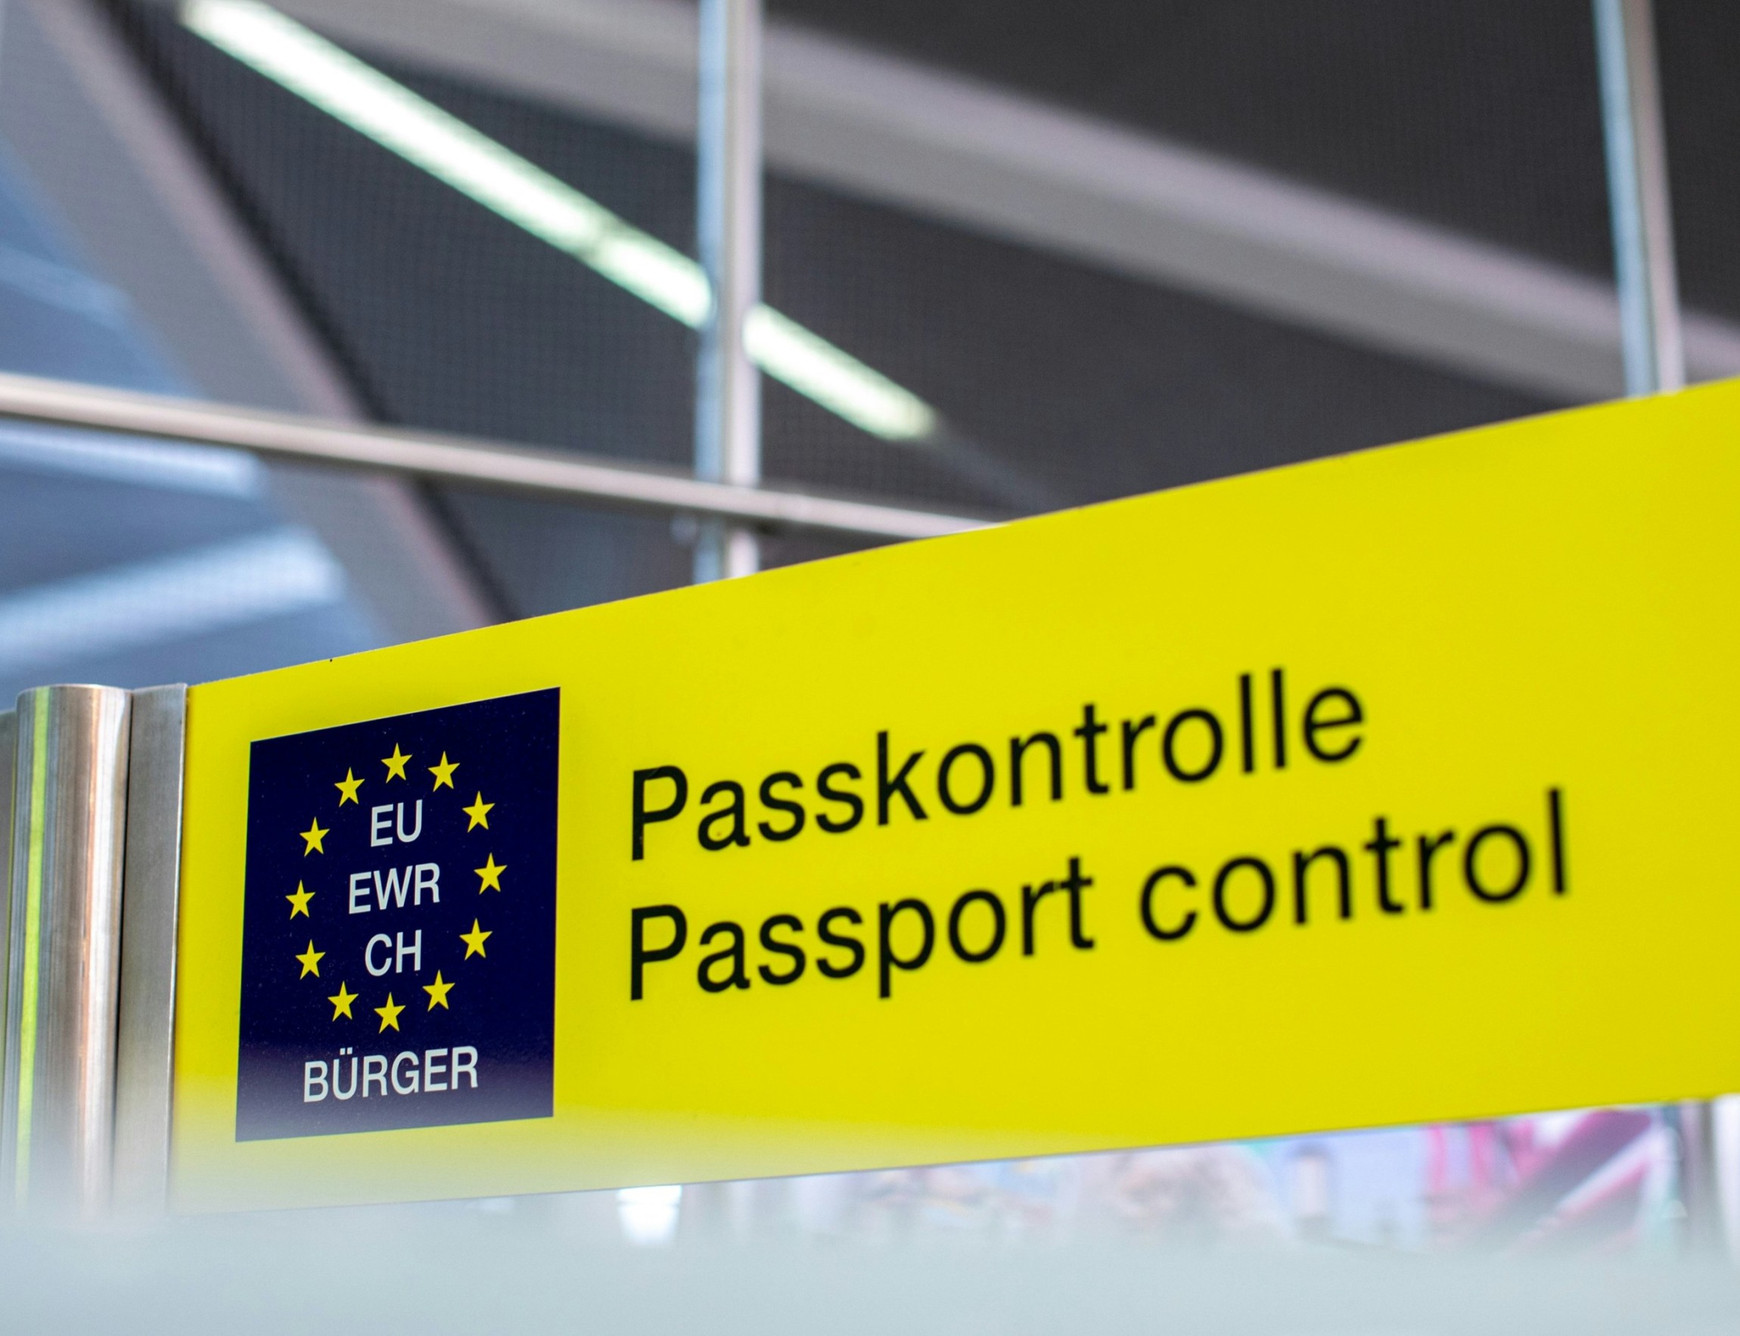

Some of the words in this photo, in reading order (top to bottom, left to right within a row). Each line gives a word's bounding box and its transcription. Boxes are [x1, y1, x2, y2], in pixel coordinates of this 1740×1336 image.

[630, 667, 1364, 863] Passkontrolle
[369, 798, 424, 848] EU
[347, 862, 441, 916] EWR
[629, 856, 1096, 1001] Passport
[1139, 787, 1568, 943] control
[364, 928, 423, 977] CH
[302, 1045, 480, 1105] BÜRGER
